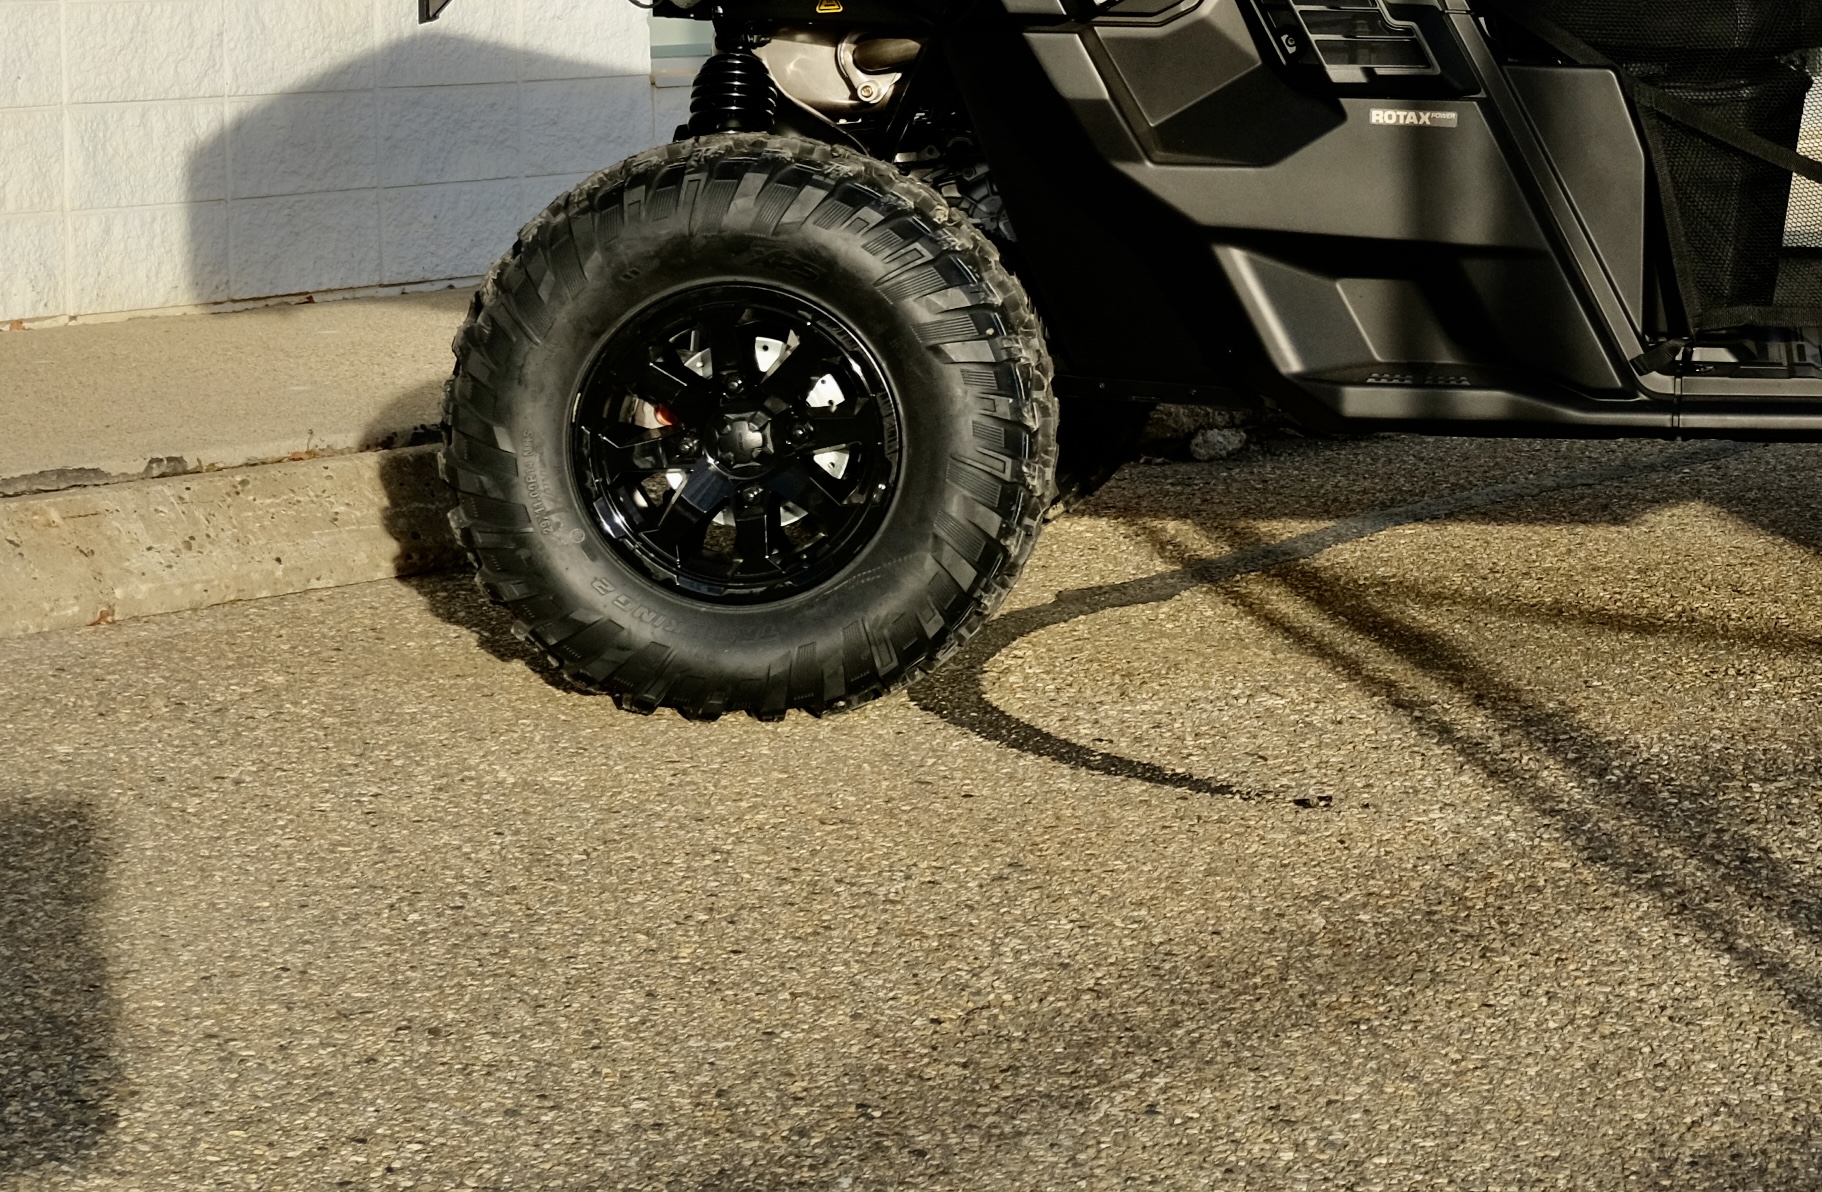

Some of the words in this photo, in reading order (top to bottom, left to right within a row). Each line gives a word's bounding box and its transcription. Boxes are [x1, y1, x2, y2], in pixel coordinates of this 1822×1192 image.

[1371, 110, 1431, 125] ROTAX
[1431, 112, 1456, 120] POWER
[590, 577, 616, 597] 2
[612, 593, 683, 636] KING
